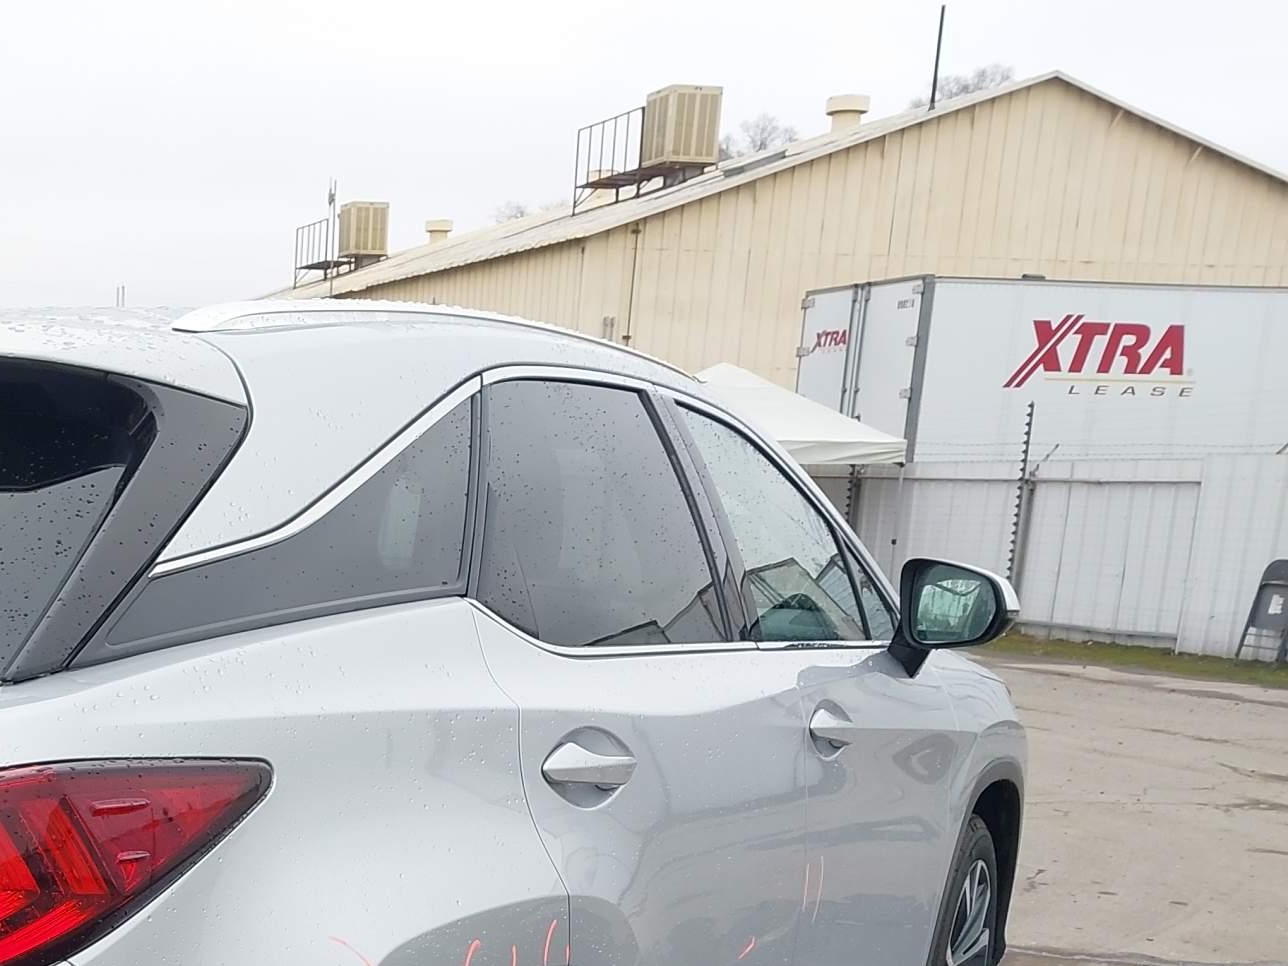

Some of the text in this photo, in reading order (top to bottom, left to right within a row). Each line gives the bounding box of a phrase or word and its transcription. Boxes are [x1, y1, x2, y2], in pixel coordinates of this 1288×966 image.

[810, 329, 848, 353] XTRA
[1002, 314, 1185, 388] XTRA
[1068, 385, 1193, 398] LEASE
